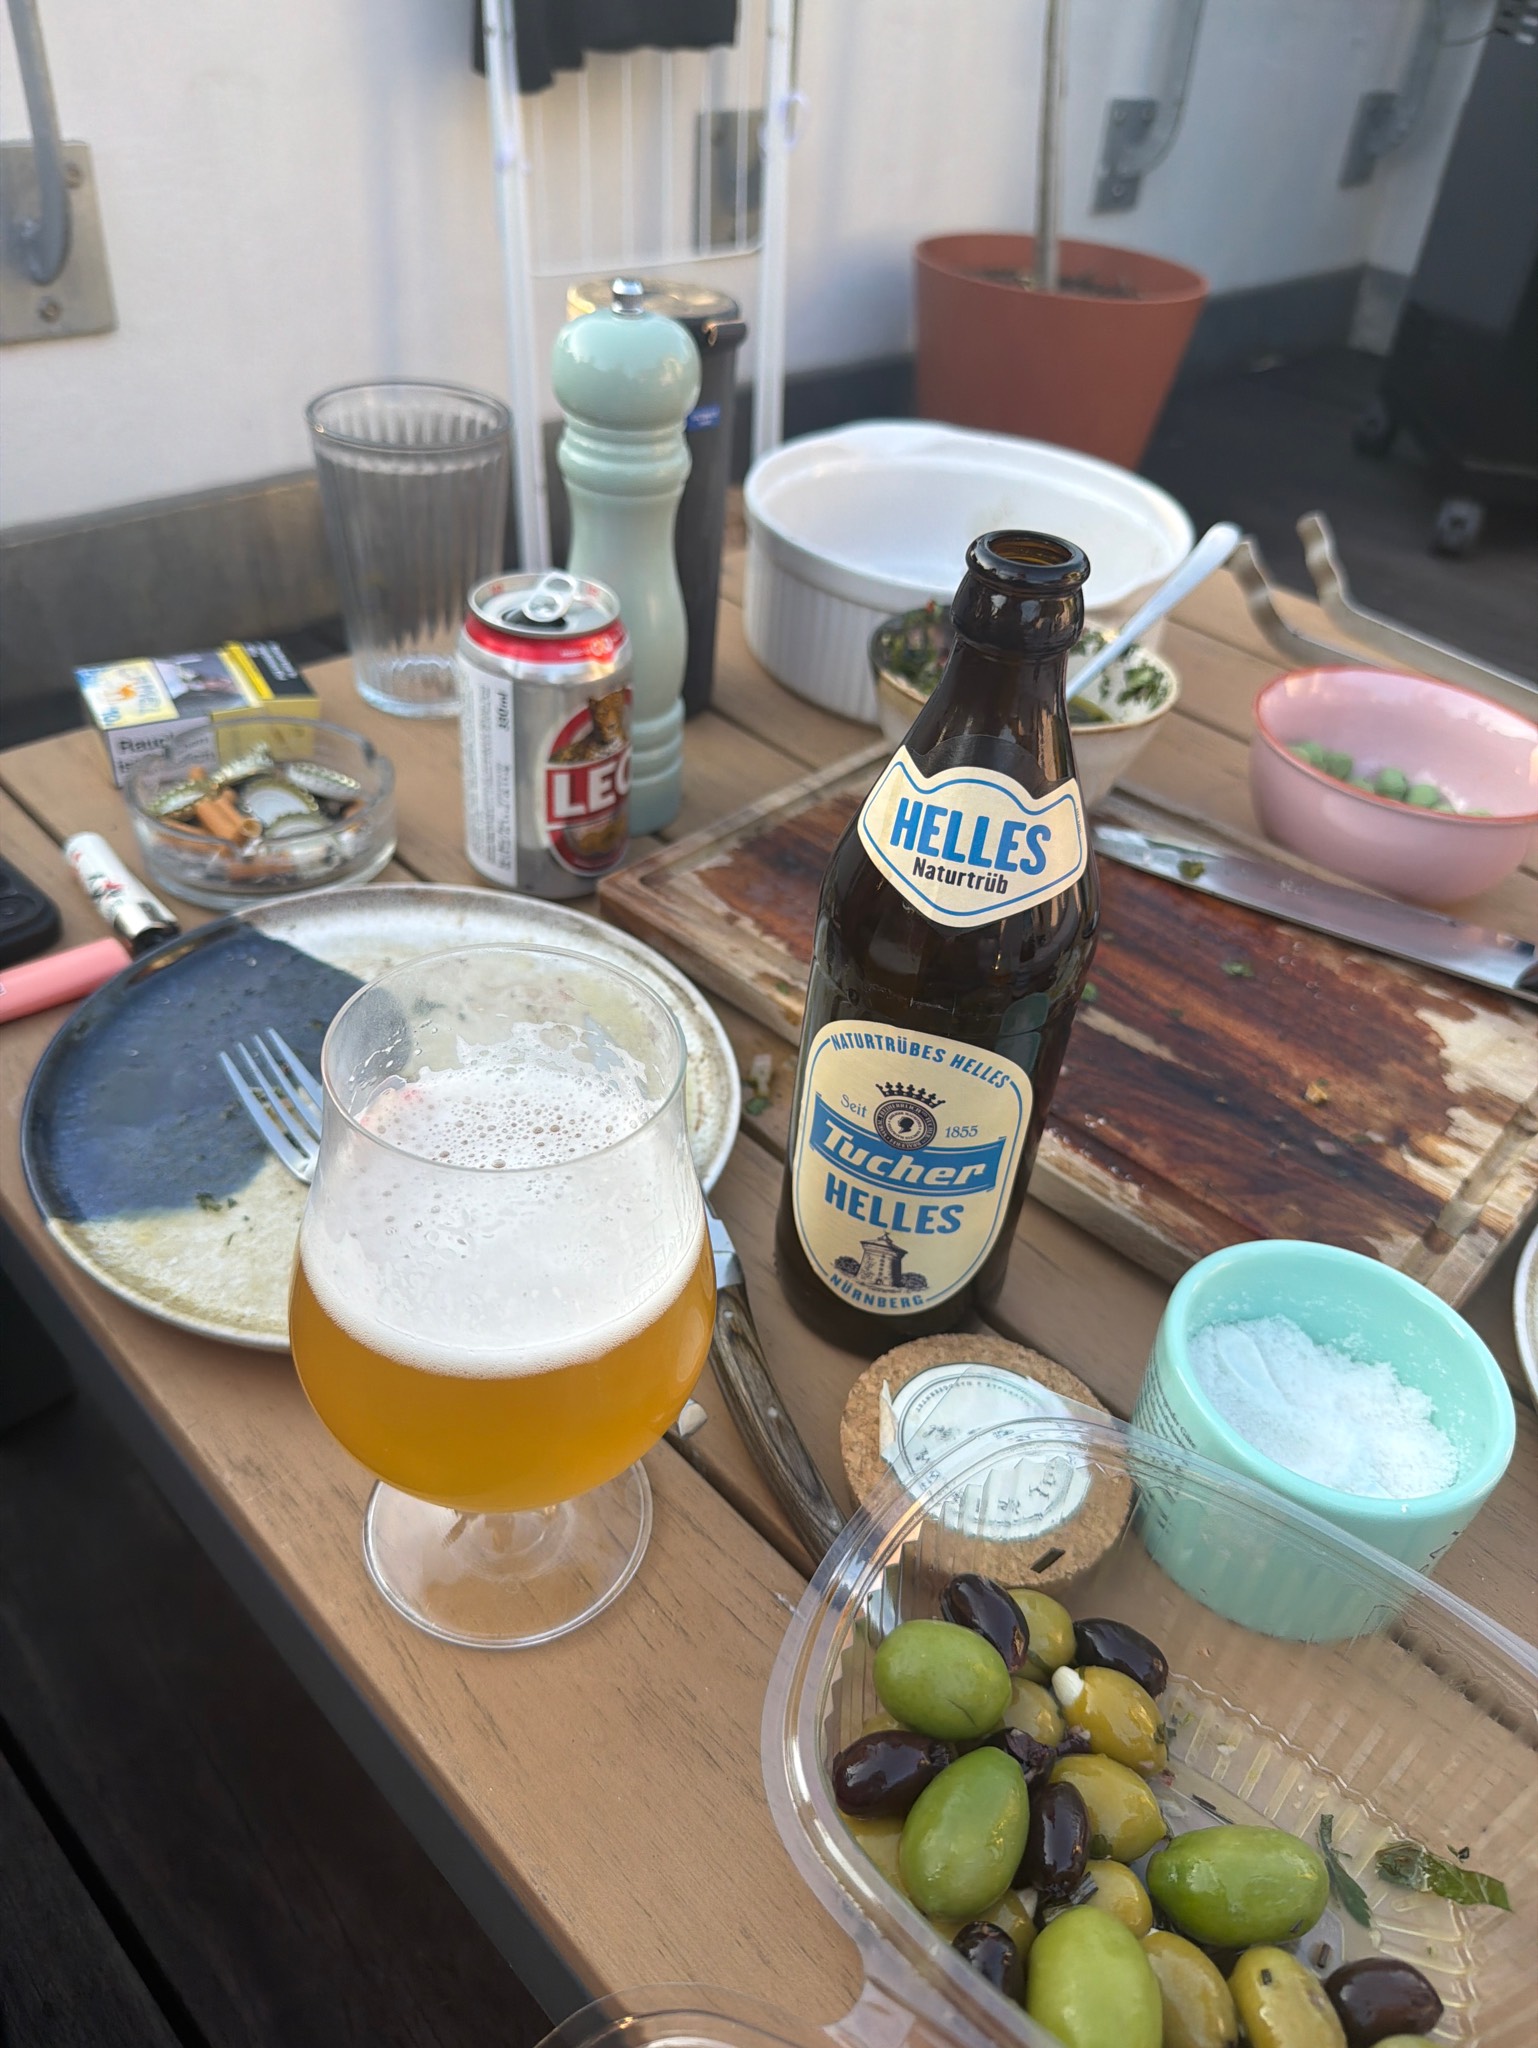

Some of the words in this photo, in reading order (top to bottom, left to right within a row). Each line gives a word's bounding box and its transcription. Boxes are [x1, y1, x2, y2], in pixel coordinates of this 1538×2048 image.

[889, 797, 1052, 876] HELLES
[912, 857, 1009, 895] Naturtrüb
[830, 1031, 947, 1063] NATURTRÜBES
[949, 1053, 1011, 1089] HELLES
[840, 1094, 868, 1119] Seit
[820, 1118, 987, 1187] Tucher
[944, 1125, 979, 1139] 1855
[824, 1171, 965, 1235] HELLES
[829, 1274, 925, 1309] NÜRNBERG
